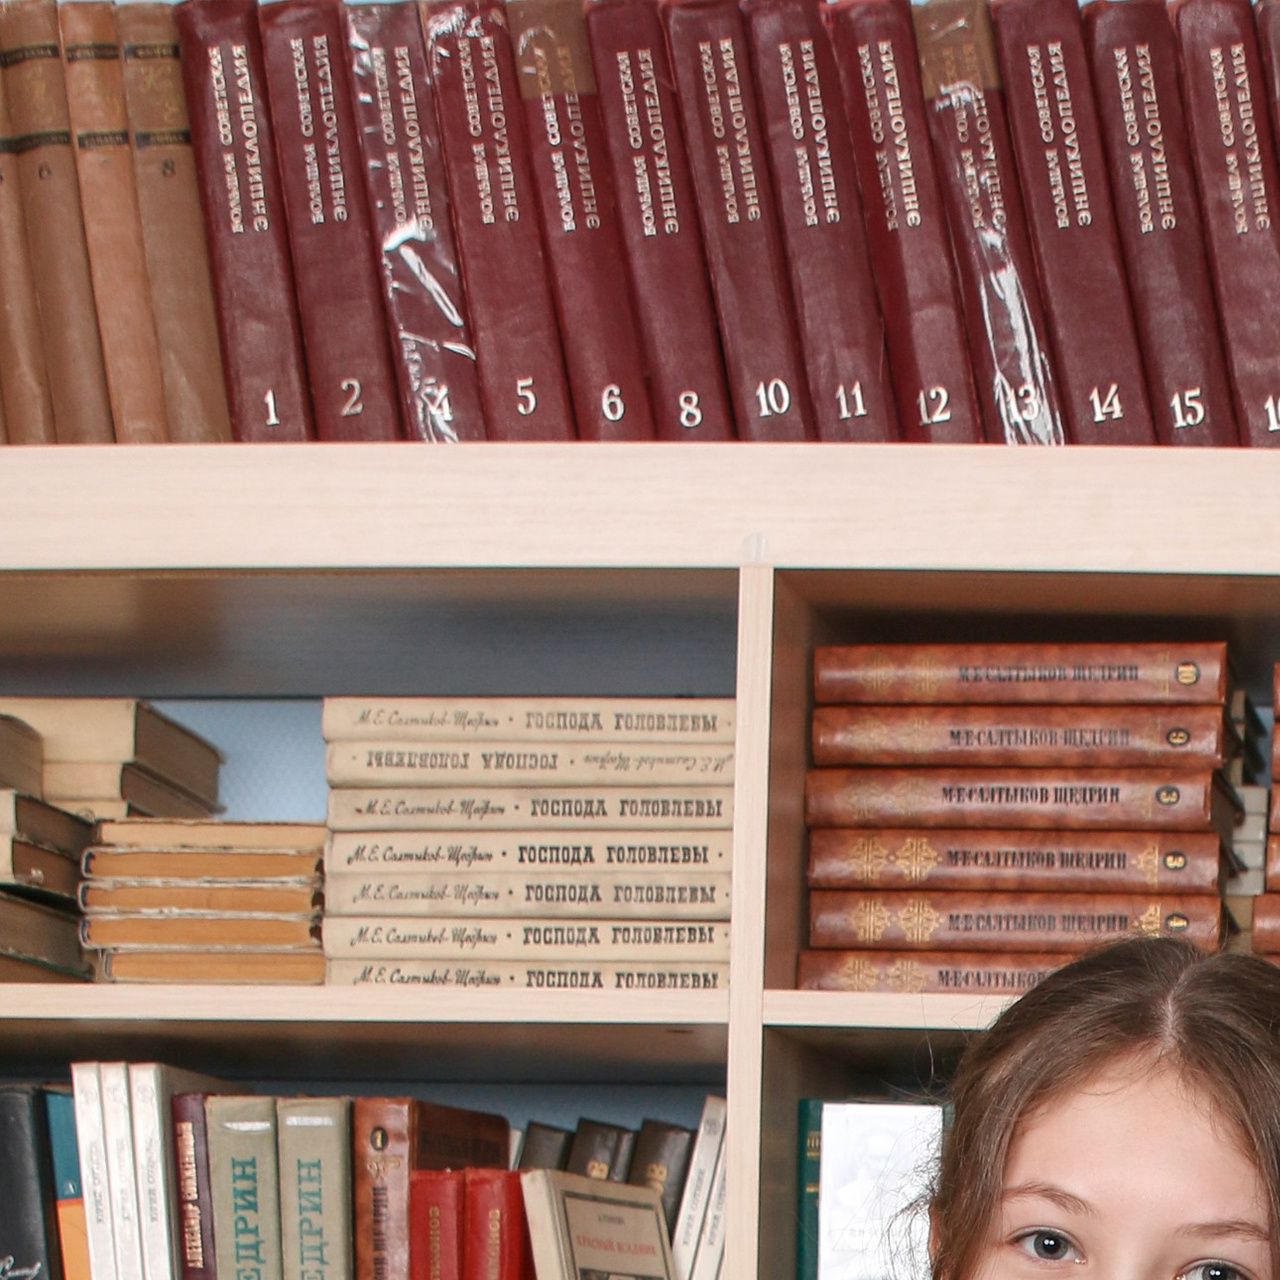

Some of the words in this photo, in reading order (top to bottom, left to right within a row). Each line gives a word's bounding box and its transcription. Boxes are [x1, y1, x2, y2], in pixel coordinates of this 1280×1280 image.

[208, 46, 233, 146] СОВЕТСКАЯ
[779, 43, 804, 140] СОВЕТСКАЯ
[1027, 45, 1054, 143] СОВЕТСКАЯ
[233, 44, 269, 231] ЭНЦИКЛОПЕДИЯ
[801, 41, 840, 224] ЭНЦИКЛОПЕДИЯ
[1048, 42, 1091, 227] ЭНЦИКЛОПЕДИЯ
[223, 152, 244, 233] БОЛЬШАЯ
[795, 147, 818, 227] БОЛЬШАЯ
[1046, 148, 1069, 229] БОЛЬШАЯ
[264, 389, 280, 426] 1
[341, 379, 364, 416] 2
[516, 378, 536, 415] 5
[601, 384, 625, 422] 6
[679, 391, 702, 428] 8
[755, 378, 790, 417] 10
[836, 381, 867, 419] 11
[917, 386, 951, 426] 12
[1009, 384, 1040, 422] 13
[1089, 384, 1123, 423] 14
[1169, 388, 1204, 428] 15
[526, 713, 603, 732] ГОСПОДА
[615, 713, 718, 732] ГОЛОВЛЕВЫ
[367, 751, 470, 768] ГОЛОВЛЕВЫ
[481, 753, 558, 769] ГОСПОДА
[530, 799, 607, 817] ГОСПОДА
[619, 799, 723, 817] ГОЛОВЛЕВЫ
[518, 847, 595, 864] ГОСПОДА
[606, 847, 709, 863] ГОЛОВЛЕВЫ
[526, 885, 602, 902] ГОСПОДА
[614, 885, 716, 901] ГОЛОВЛЕВЫ
[523, 928, 600, 945] ГОСПОДА
[611, 927, 714, 944] ГОЛОВЛЕВЫ
[526, 971, 603, 988] ГОСПОДА
[615, 971, 718, 988] ГОЛОВЛЕВЫ
